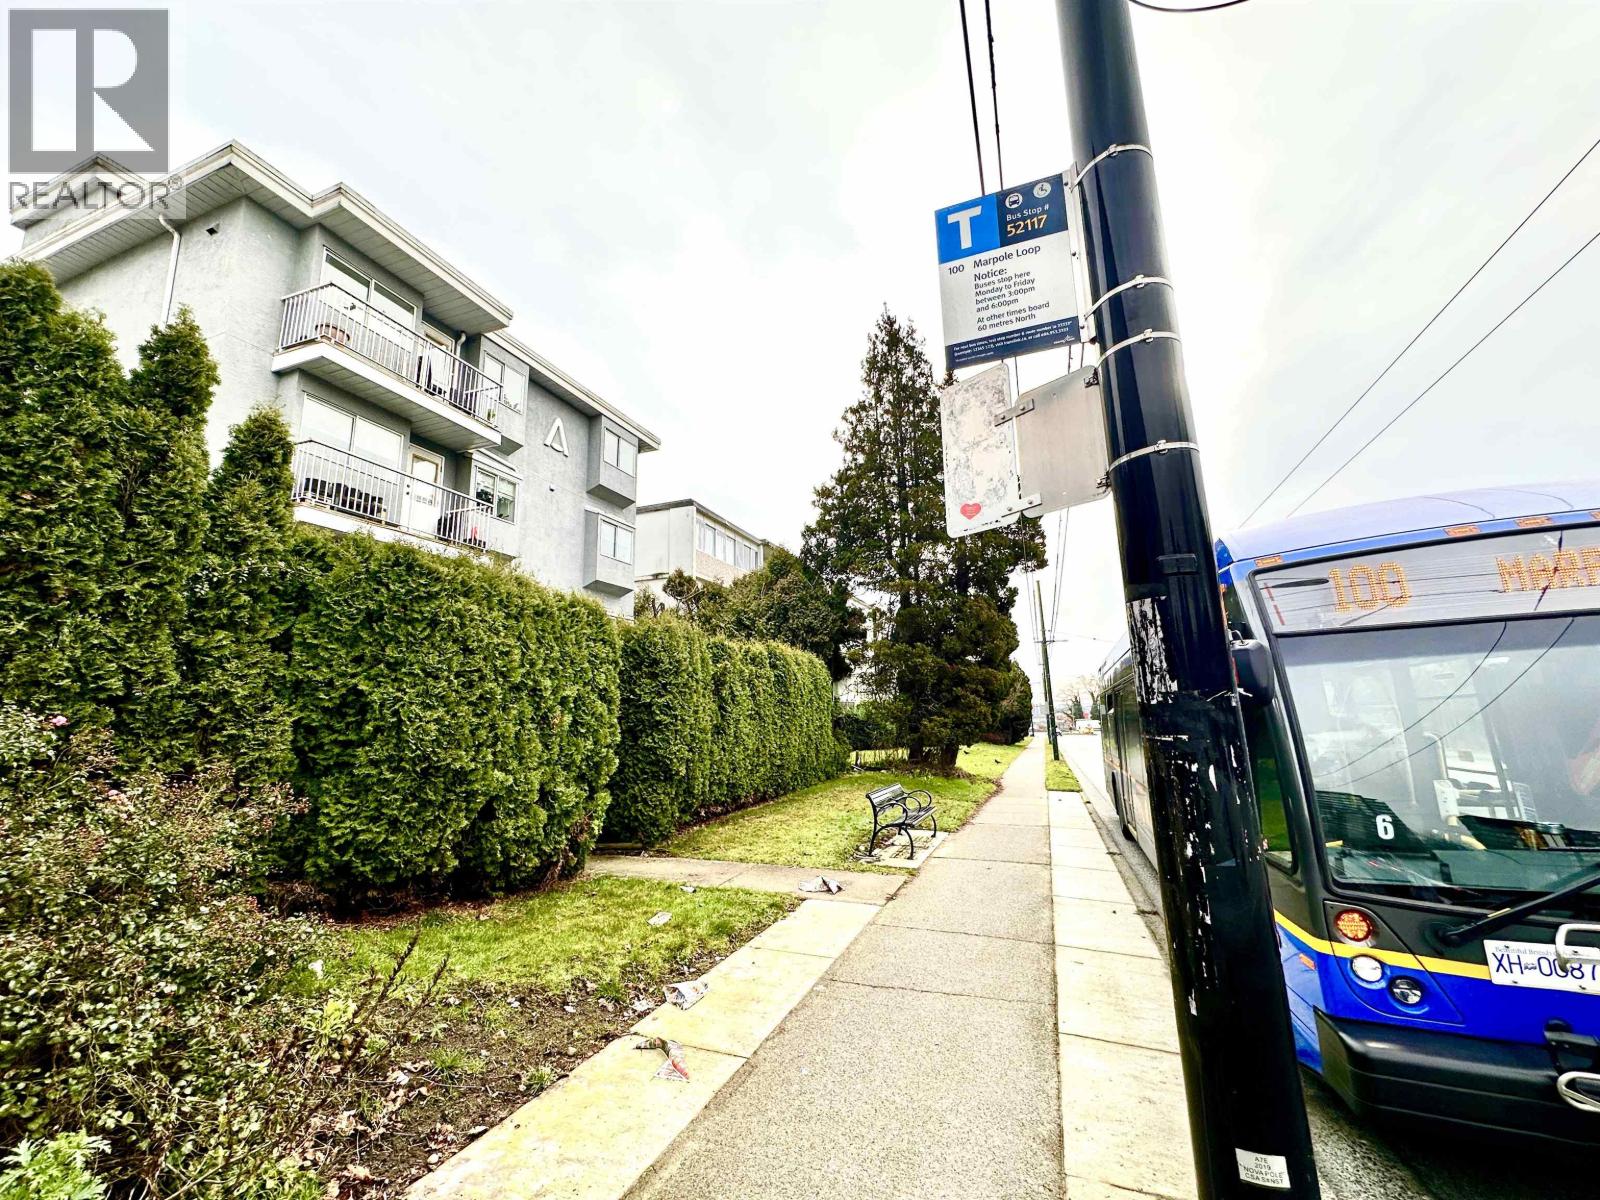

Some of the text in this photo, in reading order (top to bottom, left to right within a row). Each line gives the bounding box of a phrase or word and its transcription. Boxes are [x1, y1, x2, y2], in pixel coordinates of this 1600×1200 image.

[1006, 203, 1049, 221] Bus Stop #
[947, 205, 982, 250] T
[1007, 214, 1047, 237] 52117
[948, 245, 1041, 275] 100 Marpole Loop
[974, 268, 1007, 282] Notice:
[974, 271, 1031, 290] Buses stop here
[975, 286, 1003, 297] Monday
[1013, 278, 1035, 288] Friday
[975, 285, 1035, 305] between 3:00pm
[976, 298, 1019, 313] and 6:00pm
[986, 312, 1005, 322] other
[1006, 307, 1027, 317] times
[1028, 301, 1050, 312] board
[988, 318, 1014, 329] metres
[1015, 313, 1036, 323] North
[1329, 562, 1409, 613] 100
[1376, 814, 1395, 840] 6
[1492, 952, 1524, 975] XH
